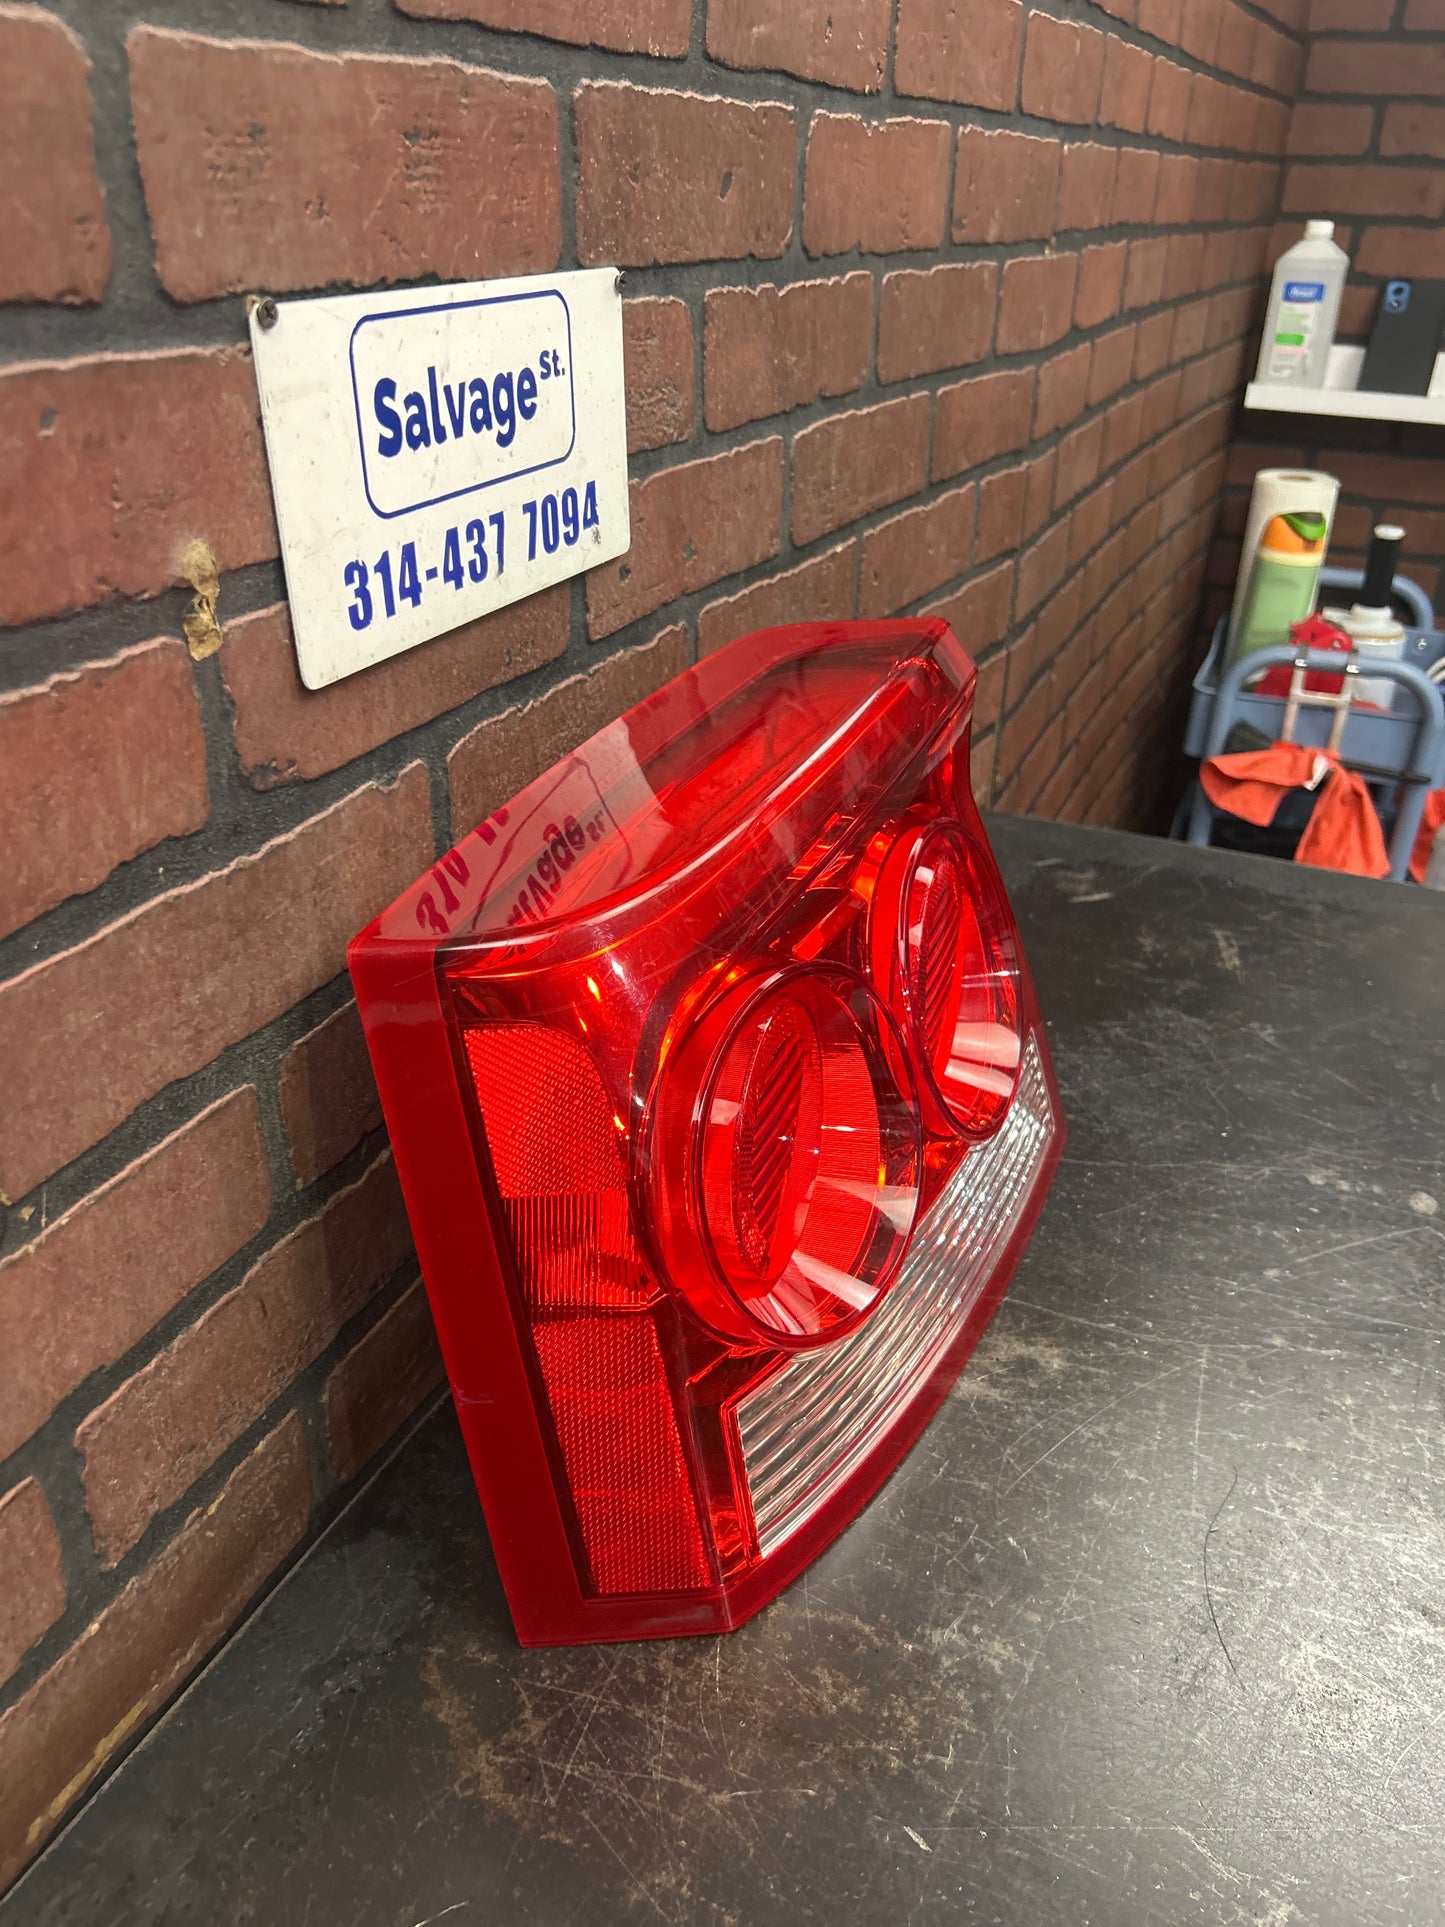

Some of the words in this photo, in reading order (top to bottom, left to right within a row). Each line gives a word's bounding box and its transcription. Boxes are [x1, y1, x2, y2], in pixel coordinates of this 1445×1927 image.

[373, 365, 539, 458] Salvage
[539, 348, 566, 380] St.
[343, 510, 505, 631] 314-437
[522, 480, 600, 562] 7094
